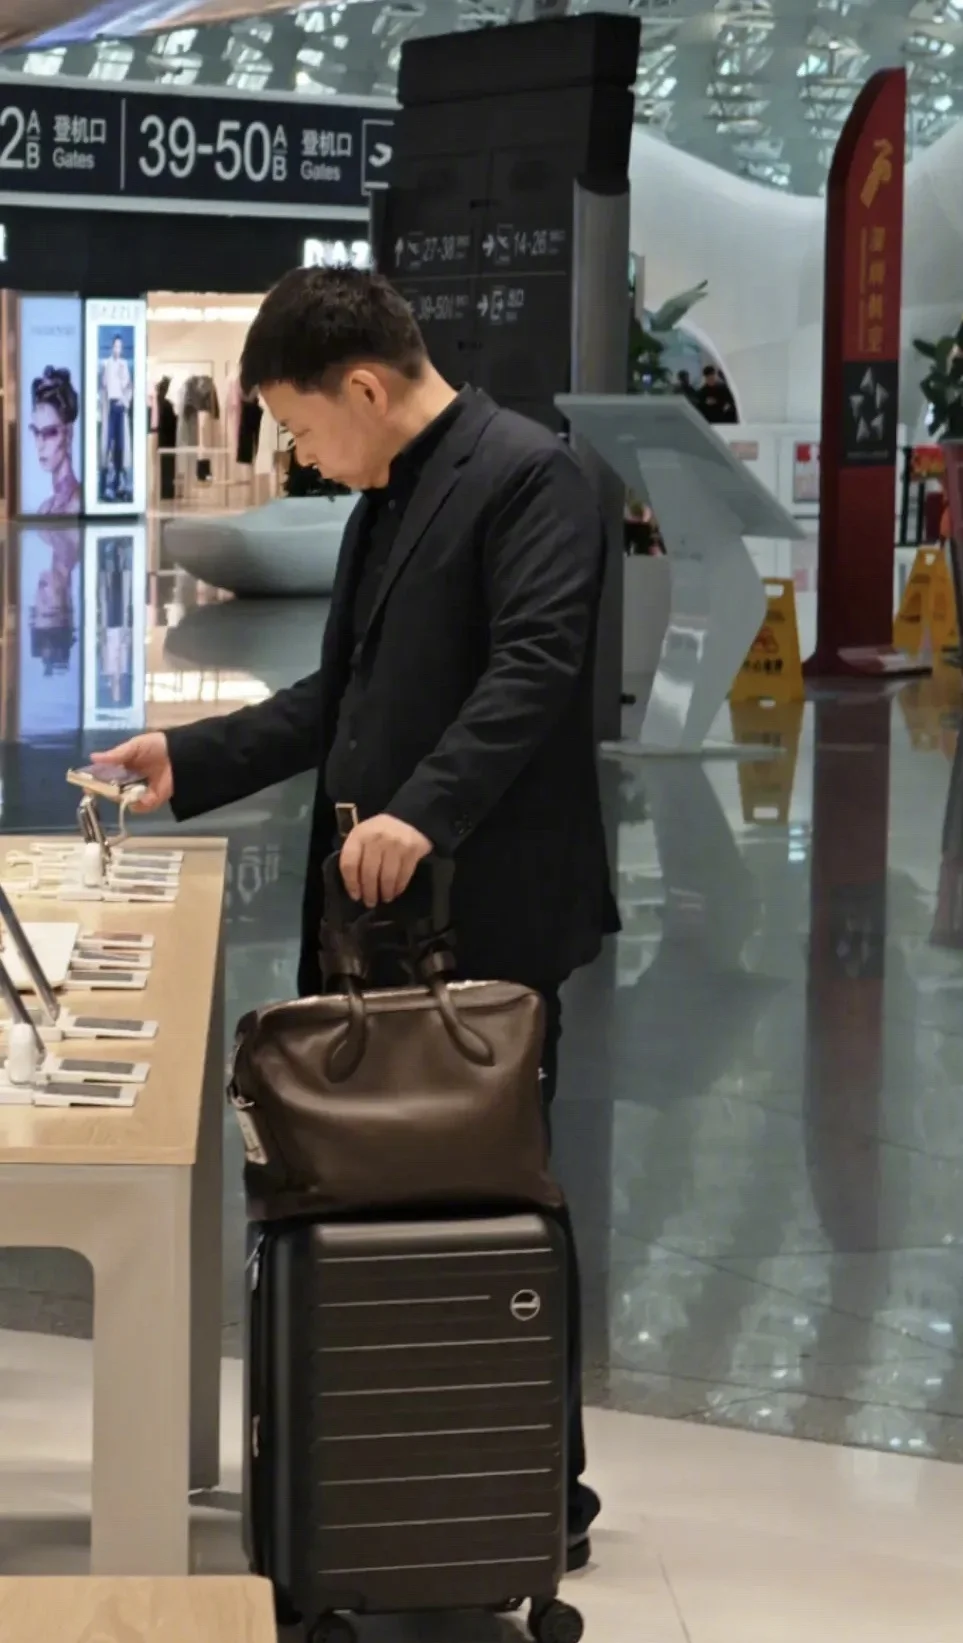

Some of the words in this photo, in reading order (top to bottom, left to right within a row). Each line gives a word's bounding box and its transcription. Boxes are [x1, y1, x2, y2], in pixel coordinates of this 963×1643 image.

[27, 109, 41, 134] A
[53, 114, 107, 144] 登机口
[138, 114, 272, 182] 39-50
[272, 124, 288, 148] A
[301, 128, 353, 157] 登机口
[26, 141, 40, 169] B
[53, 147, 95, 169] Gates
[272, 155, 287, 182] B
[300, 159, 341, 181] Gates
